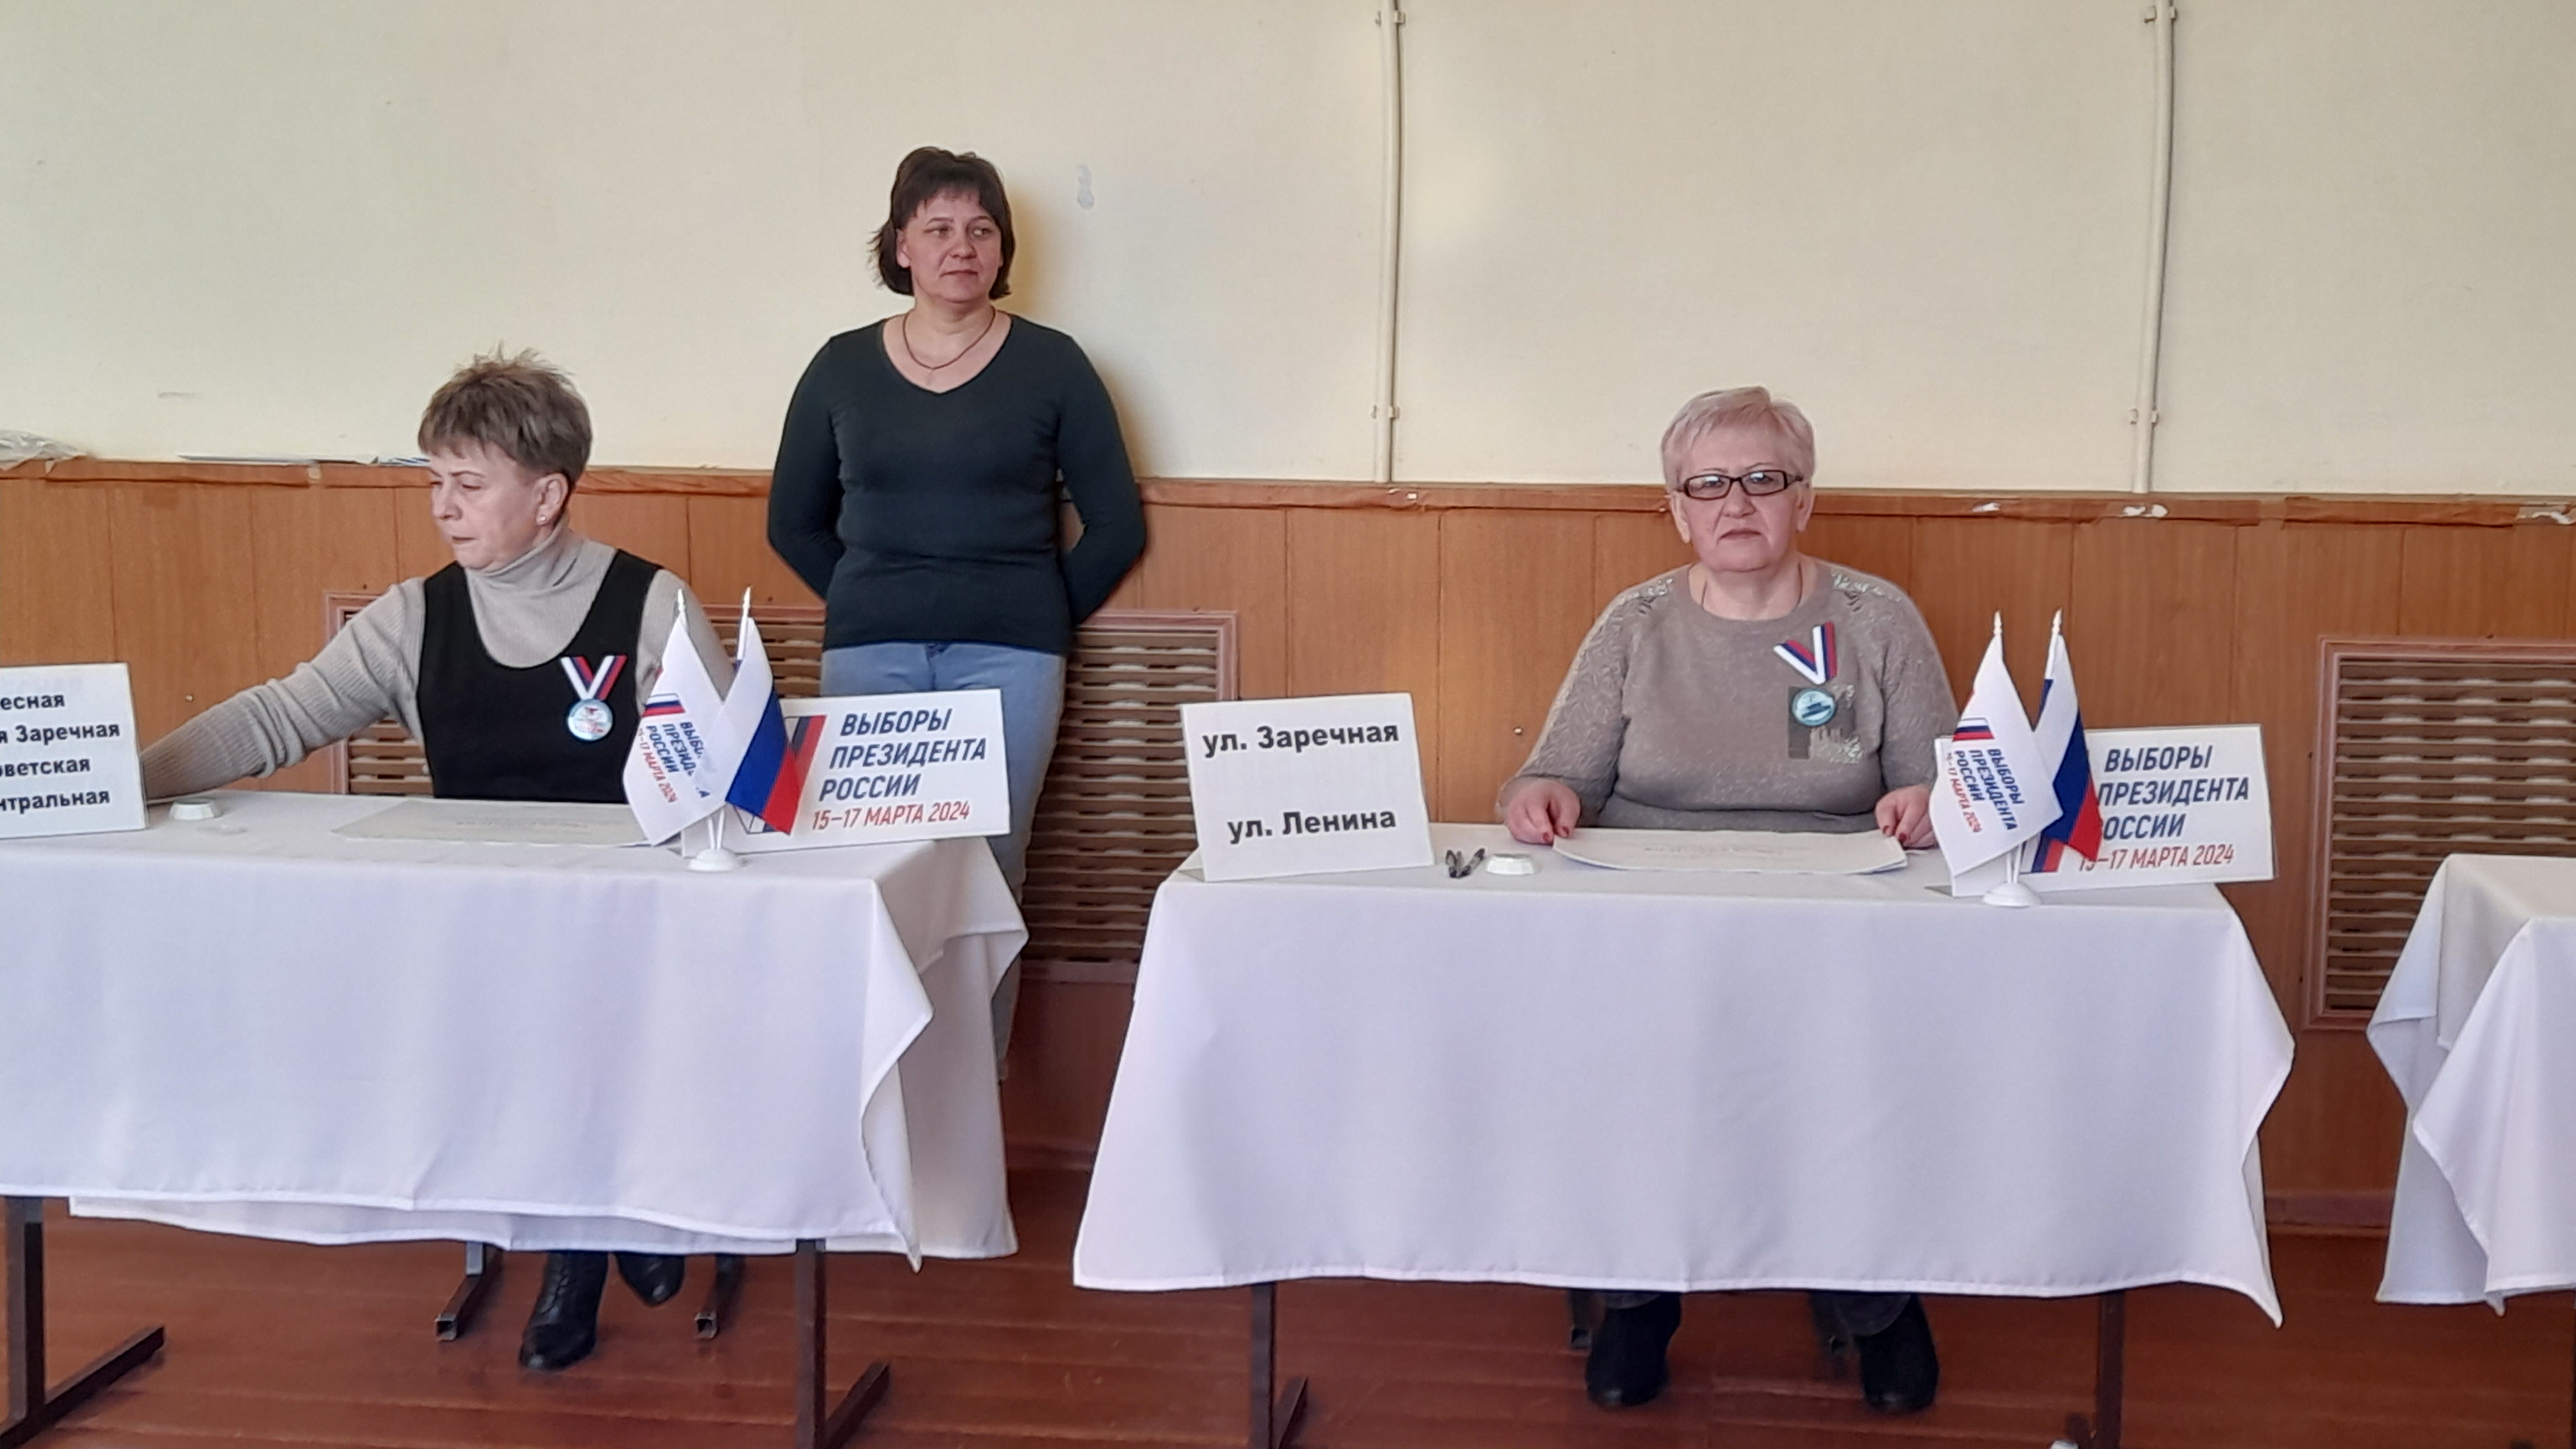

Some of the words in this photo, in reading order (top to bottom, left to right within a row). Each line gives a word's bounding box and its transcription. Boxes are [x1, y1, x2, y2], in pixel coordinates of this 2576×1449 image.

[0, 694, 66, 710] есная
[15, 724, 120, 745] Заречная
[840, 708, 952, 736] ВЫБОРЫ
[646, 725, 679, 773] РОССИИ
[829, 738, 987, 770] ПРЕЗИДЕНТА
[1202, 734, 1247, 758] ул.
[1256, 724, 1399, 753] Заречная
[0, 758, 90, 777] ветская
[662, 723, 710, 798] ПРЕЗИДА
[2105, 745, 2213, 772] ВЫБОРЫ
[819, 773, 922, 801] РОССИИ
[1953, 750, 1985, 801] РОССИИ
[1969, 750, 2018, 830] ПРЕЗИДЕНТА
[1987, 748, 2025, 804] ВЫБОРЫ
[0, 790, 110, 814] нтральная
[2098, 777, 2249, 807] ПРЕЗИДЕНТА
[812, 808, 862, 830] 15–17
[864, 803, 923, 826] МАРТА
[927, 800, 970, 822] 2024
[1227, 820, 1273, 845] ул.
[1282, 810, 1396, 835] Ленина
[2102, 813, 2186, 840] ОССИИ
[2130, 846, 2188, 869] МАРТА
[2192, 844, 2233, 866] 2024
